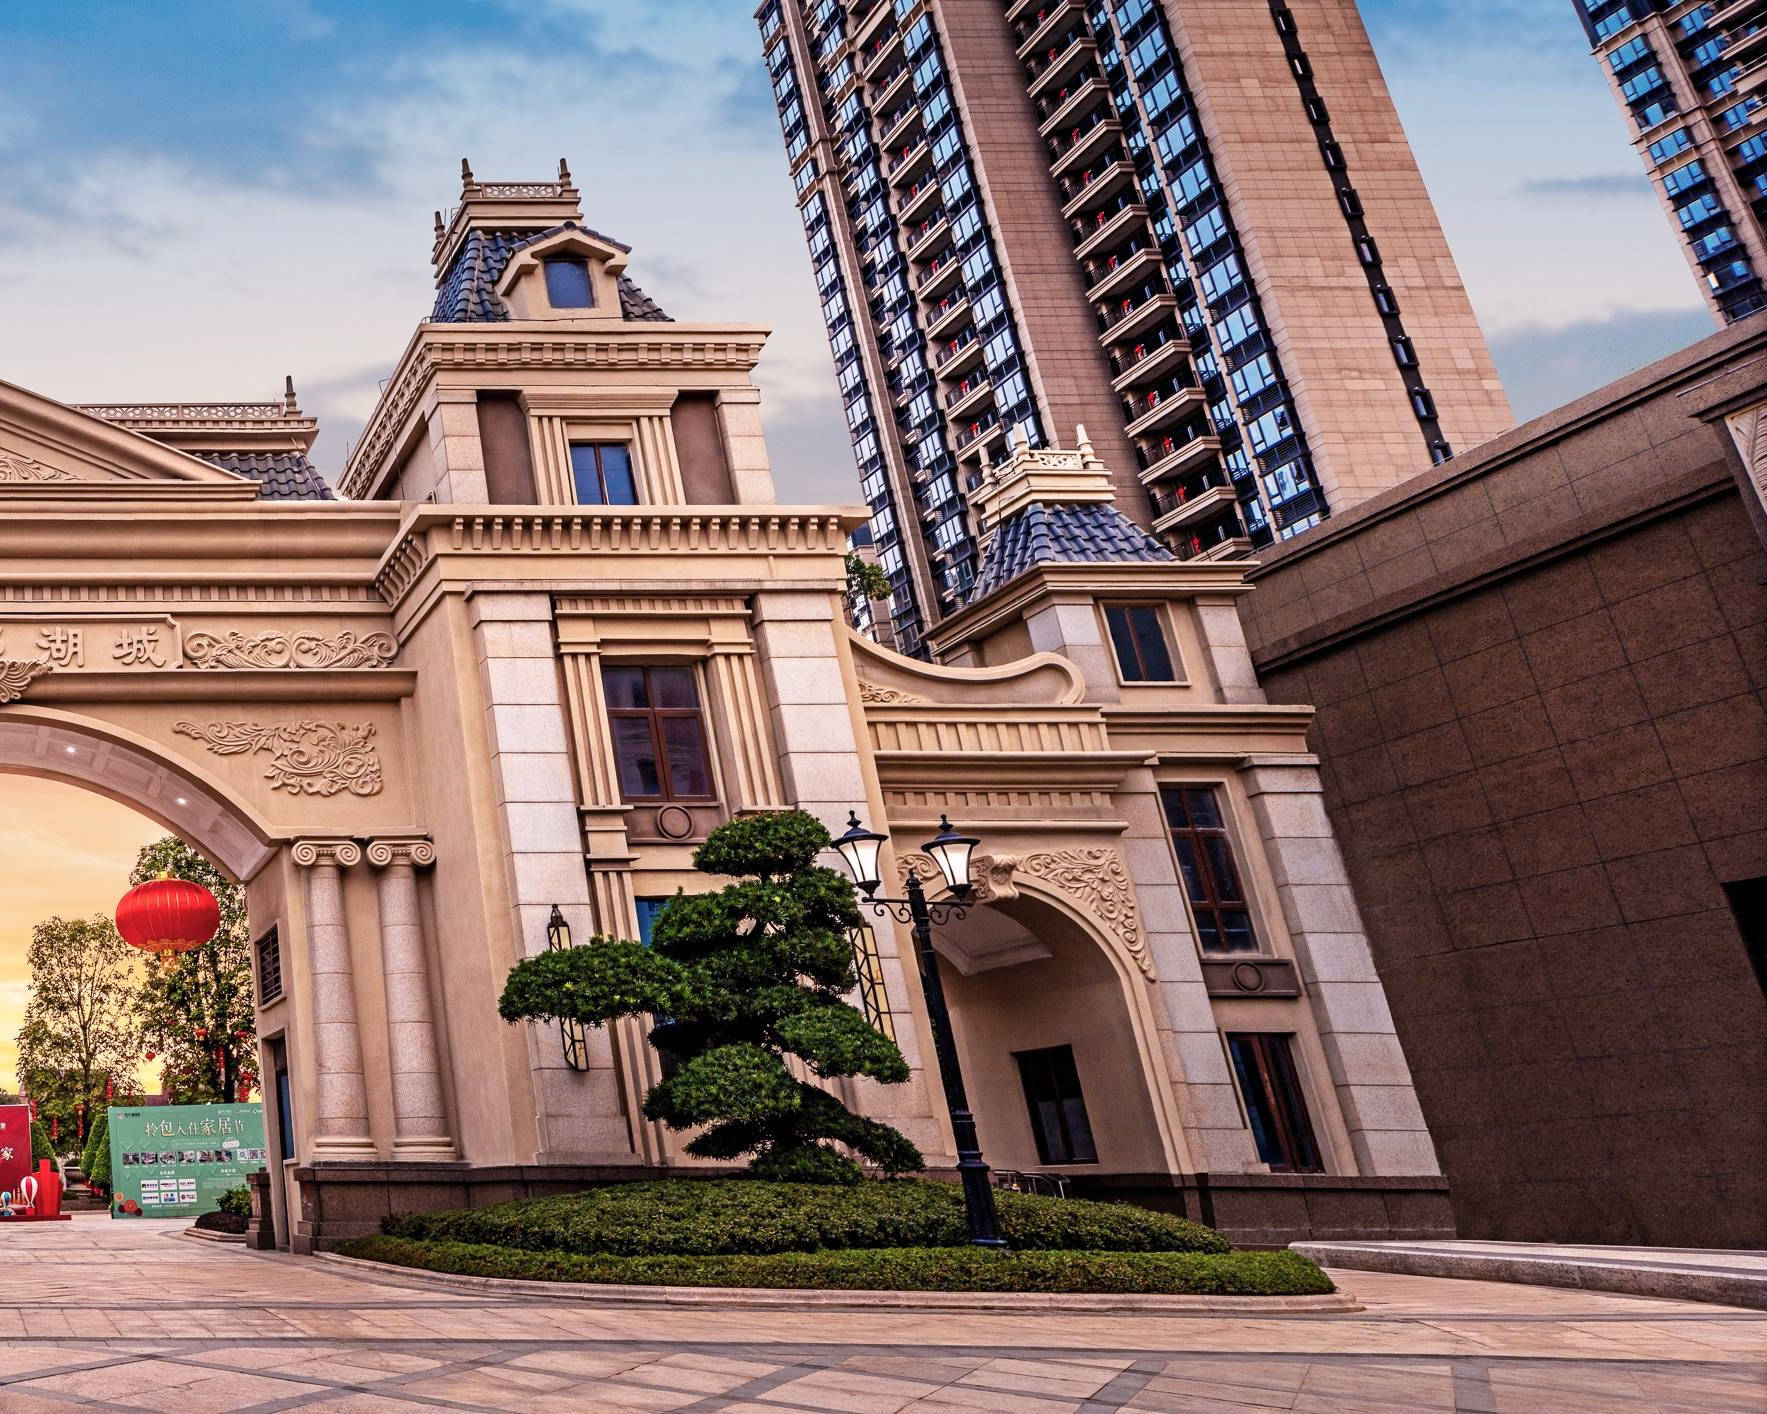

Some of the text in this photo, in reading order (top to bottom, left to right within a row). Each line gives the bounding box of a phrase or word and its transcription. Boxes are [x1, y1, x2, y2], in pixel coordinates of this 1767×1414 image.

[144, 1117, 244, 1138] 拎包入住家居节
